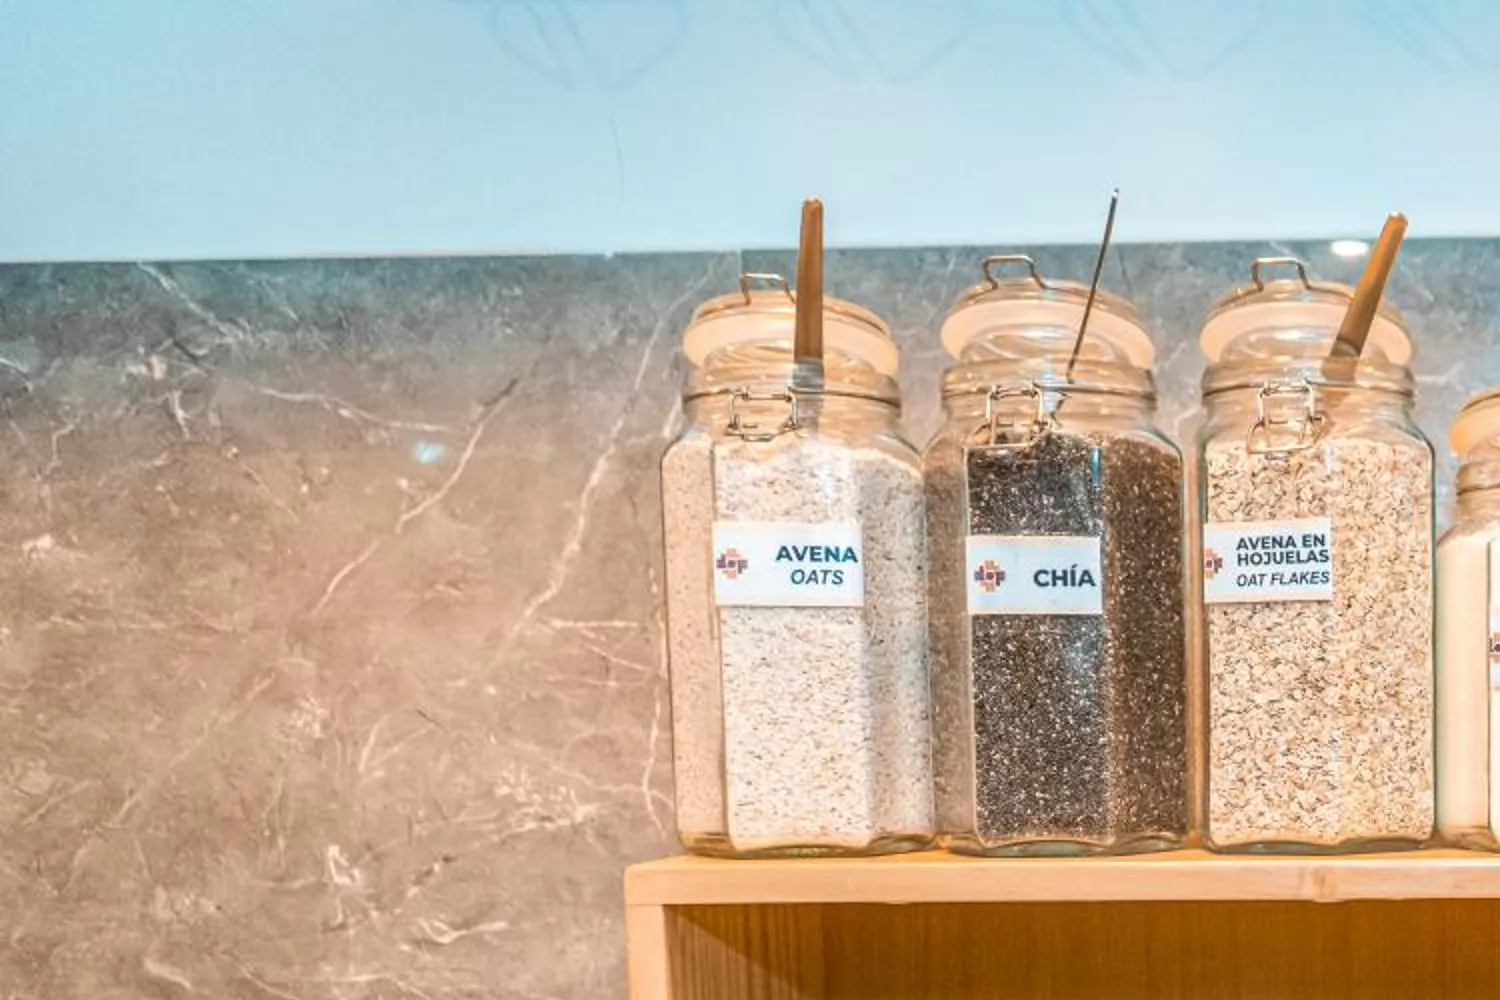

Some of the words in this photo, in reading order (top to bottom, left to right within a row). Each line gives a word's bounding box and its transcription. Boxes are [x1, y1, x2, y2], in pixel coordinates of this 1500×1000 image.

[1236, 535, 1297, 551] AVENA
[1302, 533, 1326, 548] EN
[775, 545, 859, 563] AVENA
[1236, 549, 1330, 567] HOJUELAS
[790, 569, 844, 585] OATS
[1033, 563, 1097, 588] CHÍA
[1236, 573, 1267, 588] OAT
[1269, 571, 1331, 587] FLAKES
